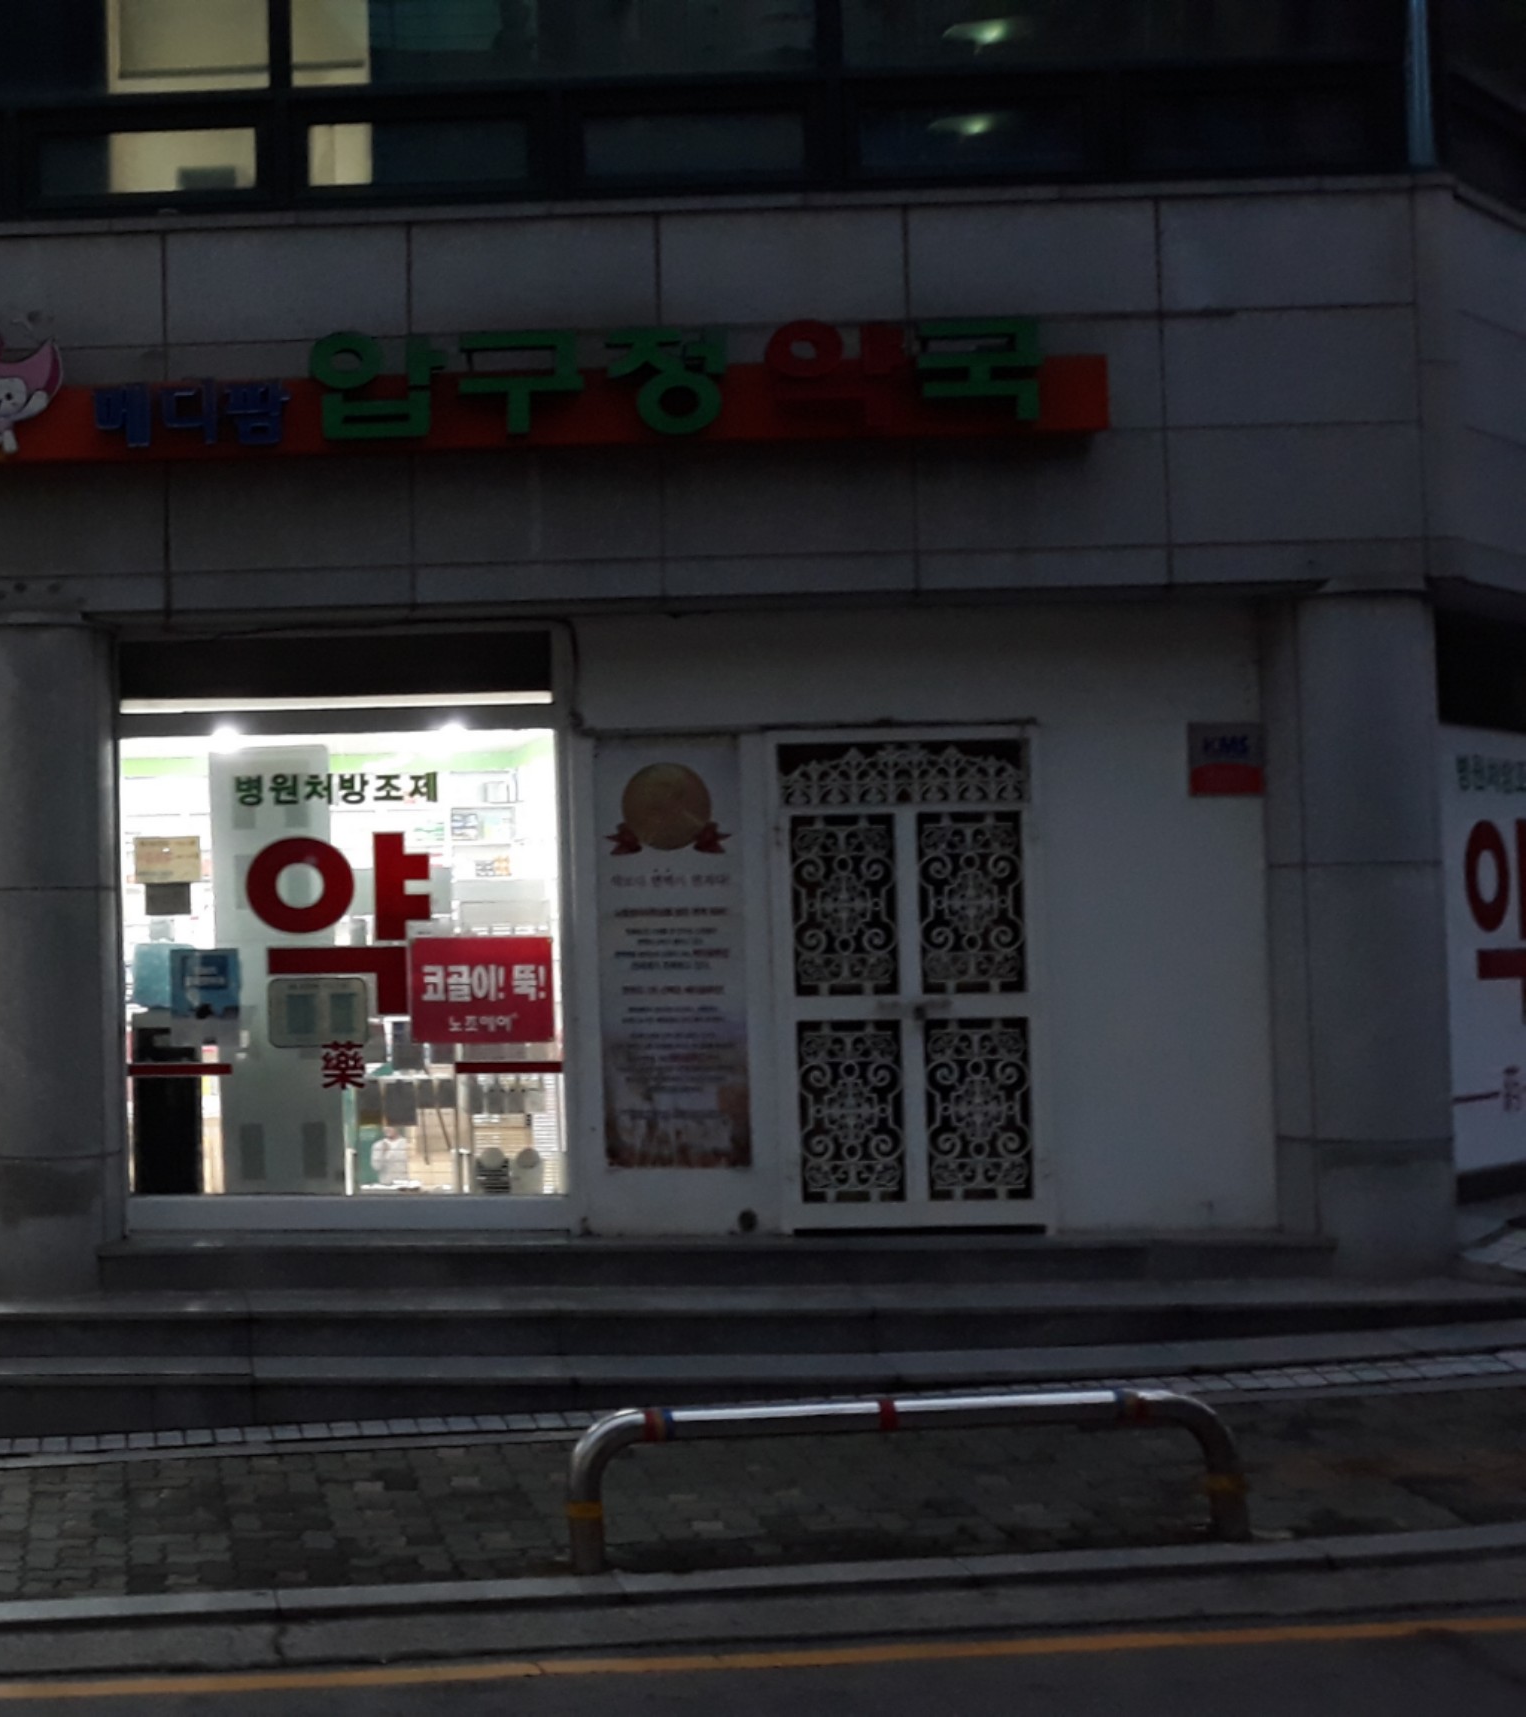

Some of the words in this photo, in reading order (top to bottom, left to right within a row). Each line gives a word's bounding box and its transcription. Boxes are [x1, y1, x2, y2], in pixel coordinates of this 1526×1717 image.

[92, 376, 289, 449] 메디팜
[307, 317, 1043, 441] 압구정약국
[234, 771, 439, 806] 병원처방조제
[246, 832, 431, 1014] 약
[421, 963, 506, 1002] 코골이!
[512, 963, 547, 1002] 뚝!
